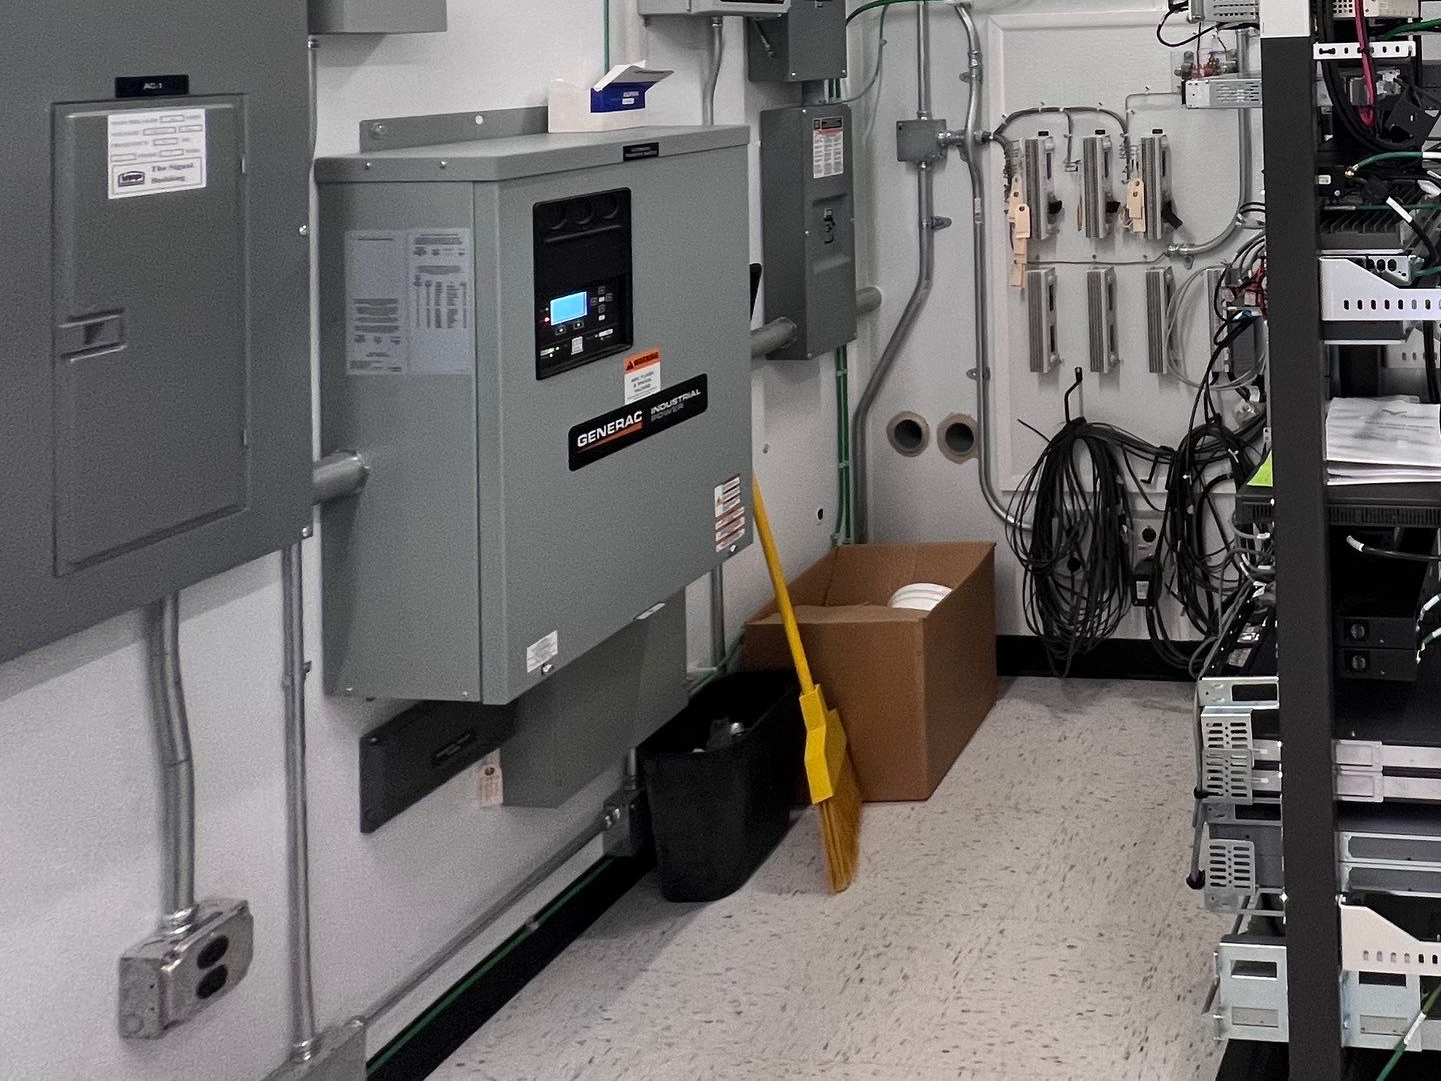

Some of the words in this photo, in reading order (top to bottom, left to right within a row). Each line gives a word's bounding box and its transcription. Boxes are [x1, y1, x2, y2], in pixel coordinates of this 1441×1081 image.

[577, 410, 643, 448] GENERAC
[651, 388, 701, 415] INDUSTRIAL
[651, 402, 685, 422] POWER
